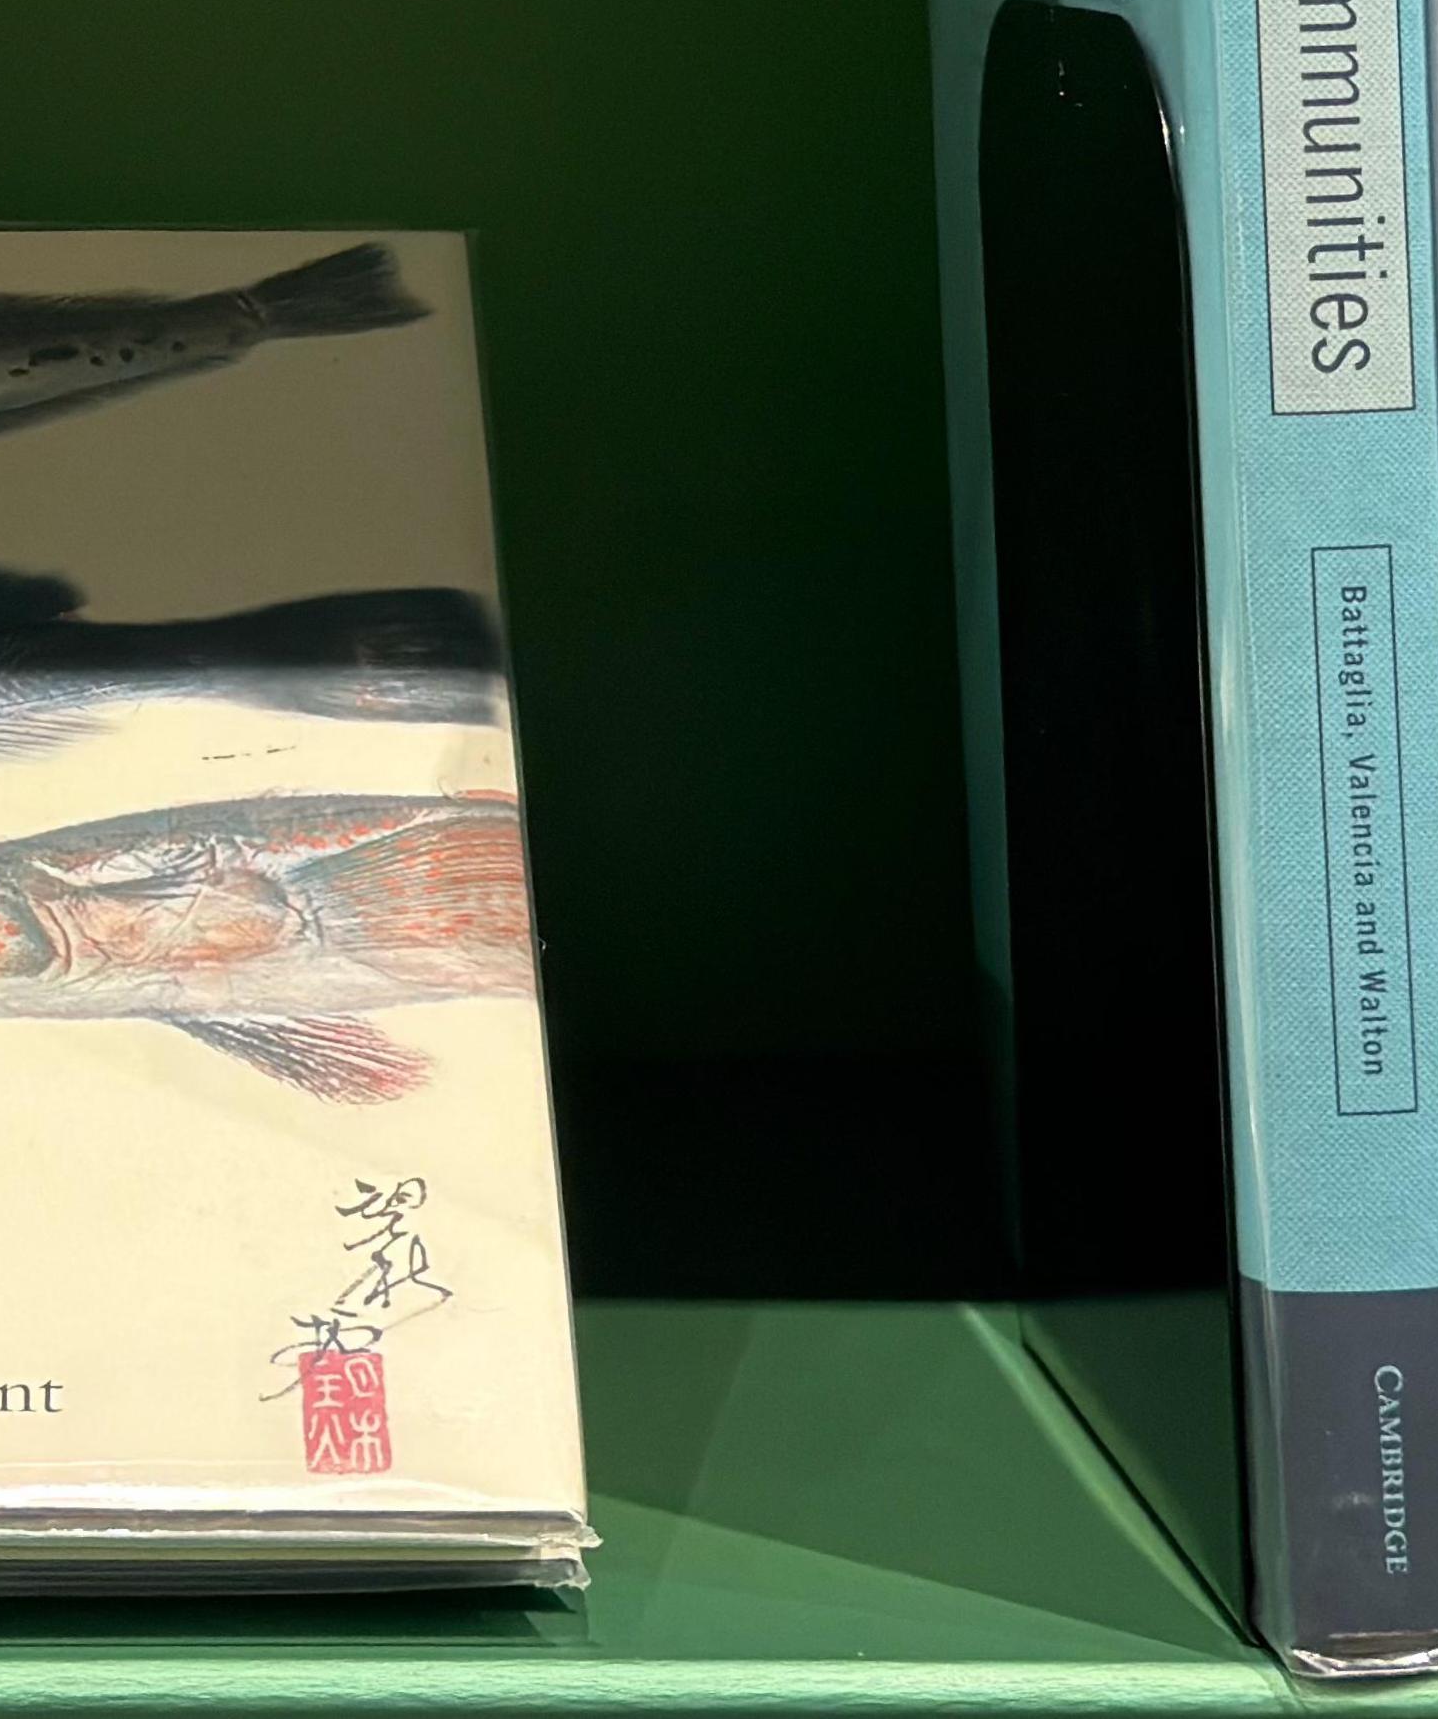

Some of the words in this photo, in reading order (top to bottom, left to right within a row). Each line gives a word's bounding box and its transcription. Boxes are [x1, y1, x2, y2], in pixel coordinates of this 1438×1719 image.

[1340, 584, 1371, 742] Battaglia,
[1345, 749, 1379, 899] Valencia
[1355, 907, 1379, 957] and
[1356, 967, 1385, 1077] Walton
[1371, 1362, 1407, 1576] CAMBRIDGE
